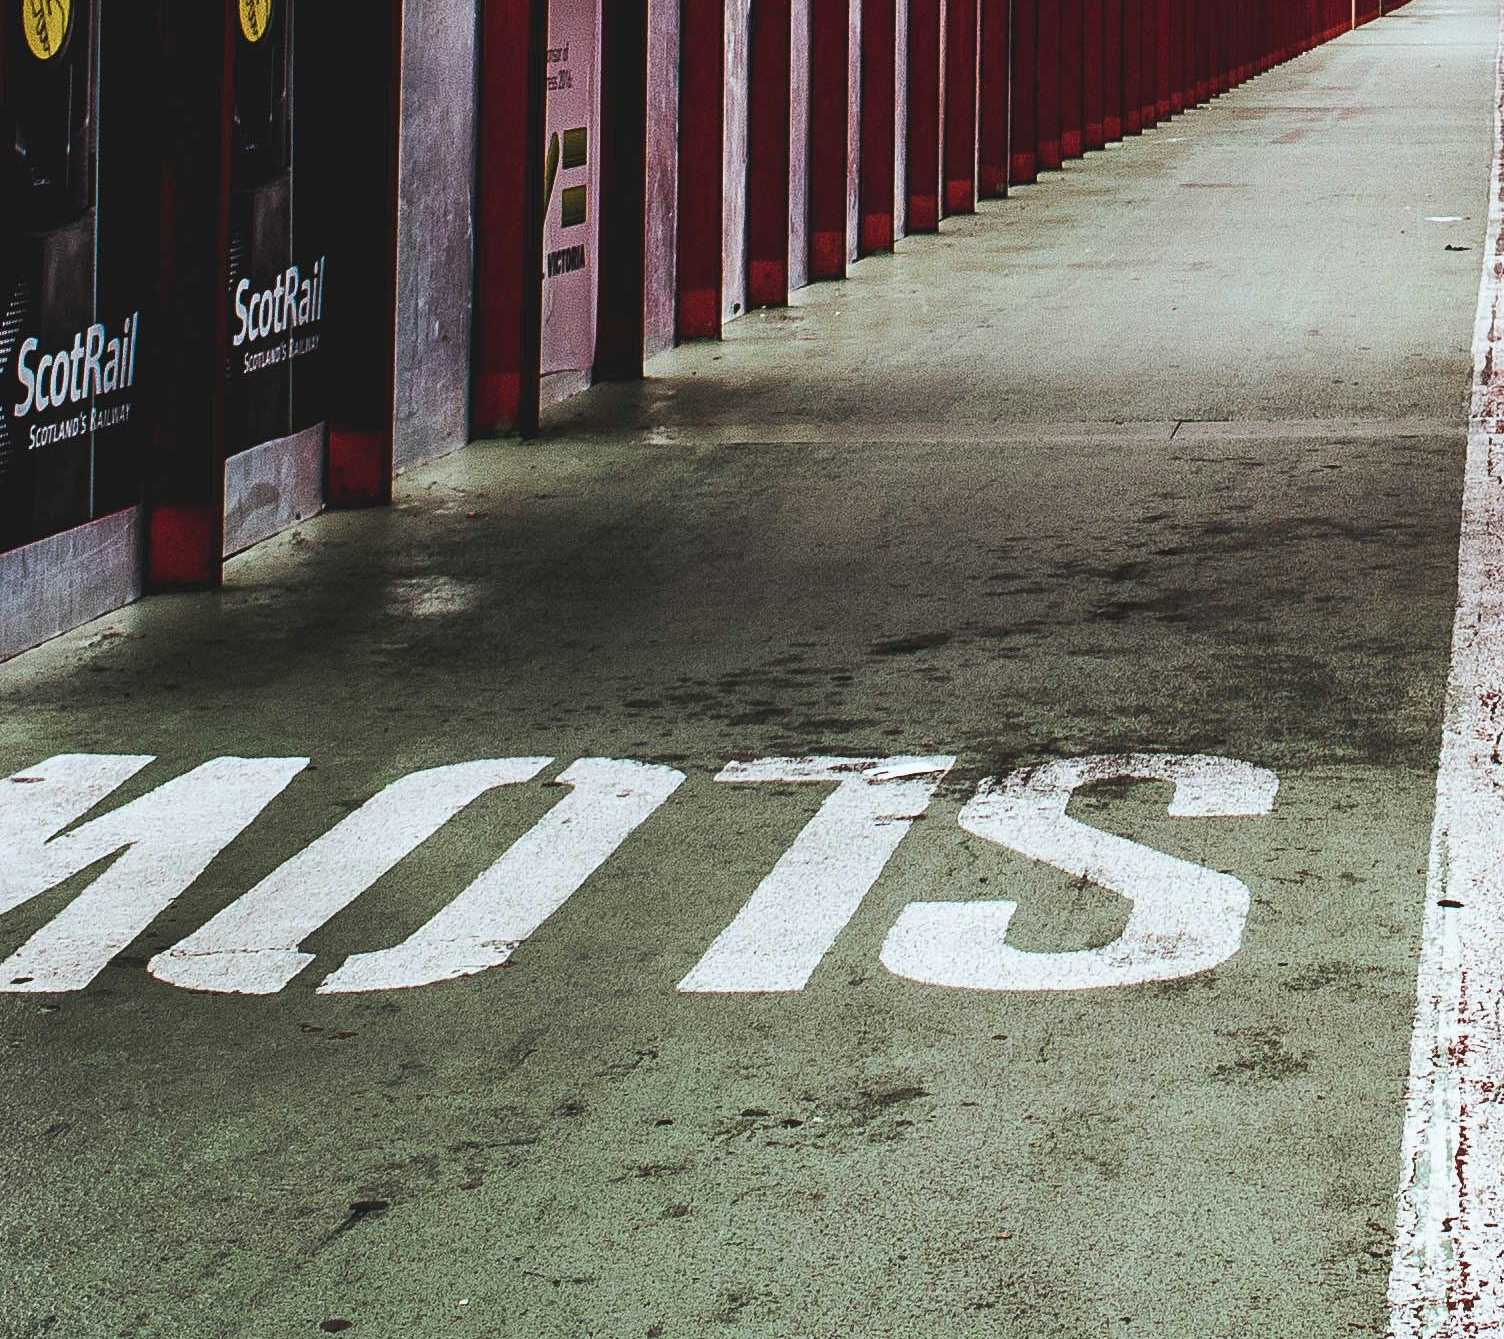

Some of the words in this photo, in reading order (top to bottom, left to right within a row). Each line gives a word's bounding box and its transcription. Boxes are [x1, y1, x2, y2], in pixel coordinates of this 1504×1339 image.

[233, 255, 325, 346] ScotRail
[14, 311, 139, 417] ScotRail
[89, 403, 132, 432] RAILWAY
